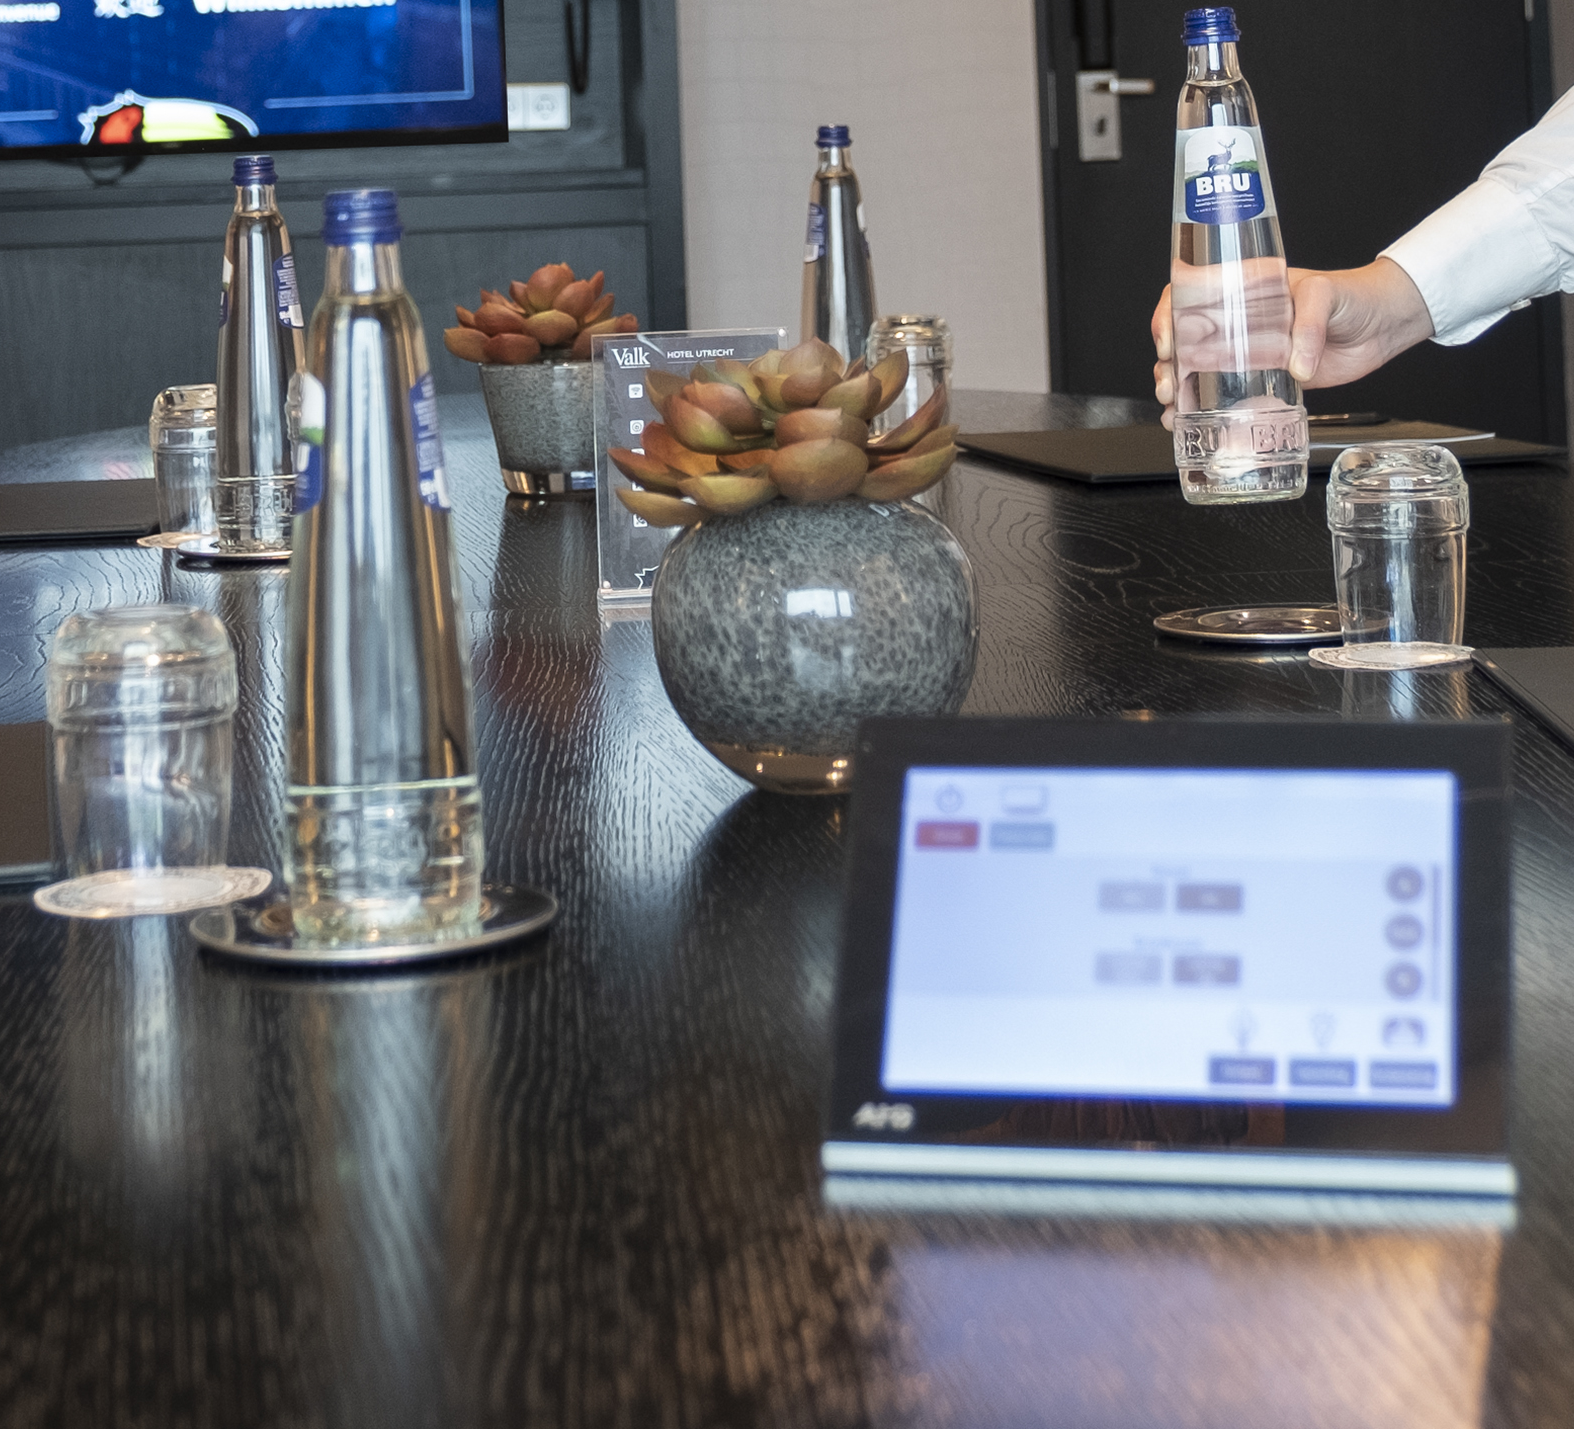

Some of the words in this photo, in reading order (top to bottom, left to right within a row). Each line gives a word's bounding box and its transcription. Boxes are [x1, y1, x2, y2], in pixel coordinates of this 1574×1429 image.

[1195, 173, 1251, 196] BRU
[611, 346, 651, 367] Valk
[667, 351, 694, 359] HOTEL
[696, 348, 735, 358] UTRECHT
